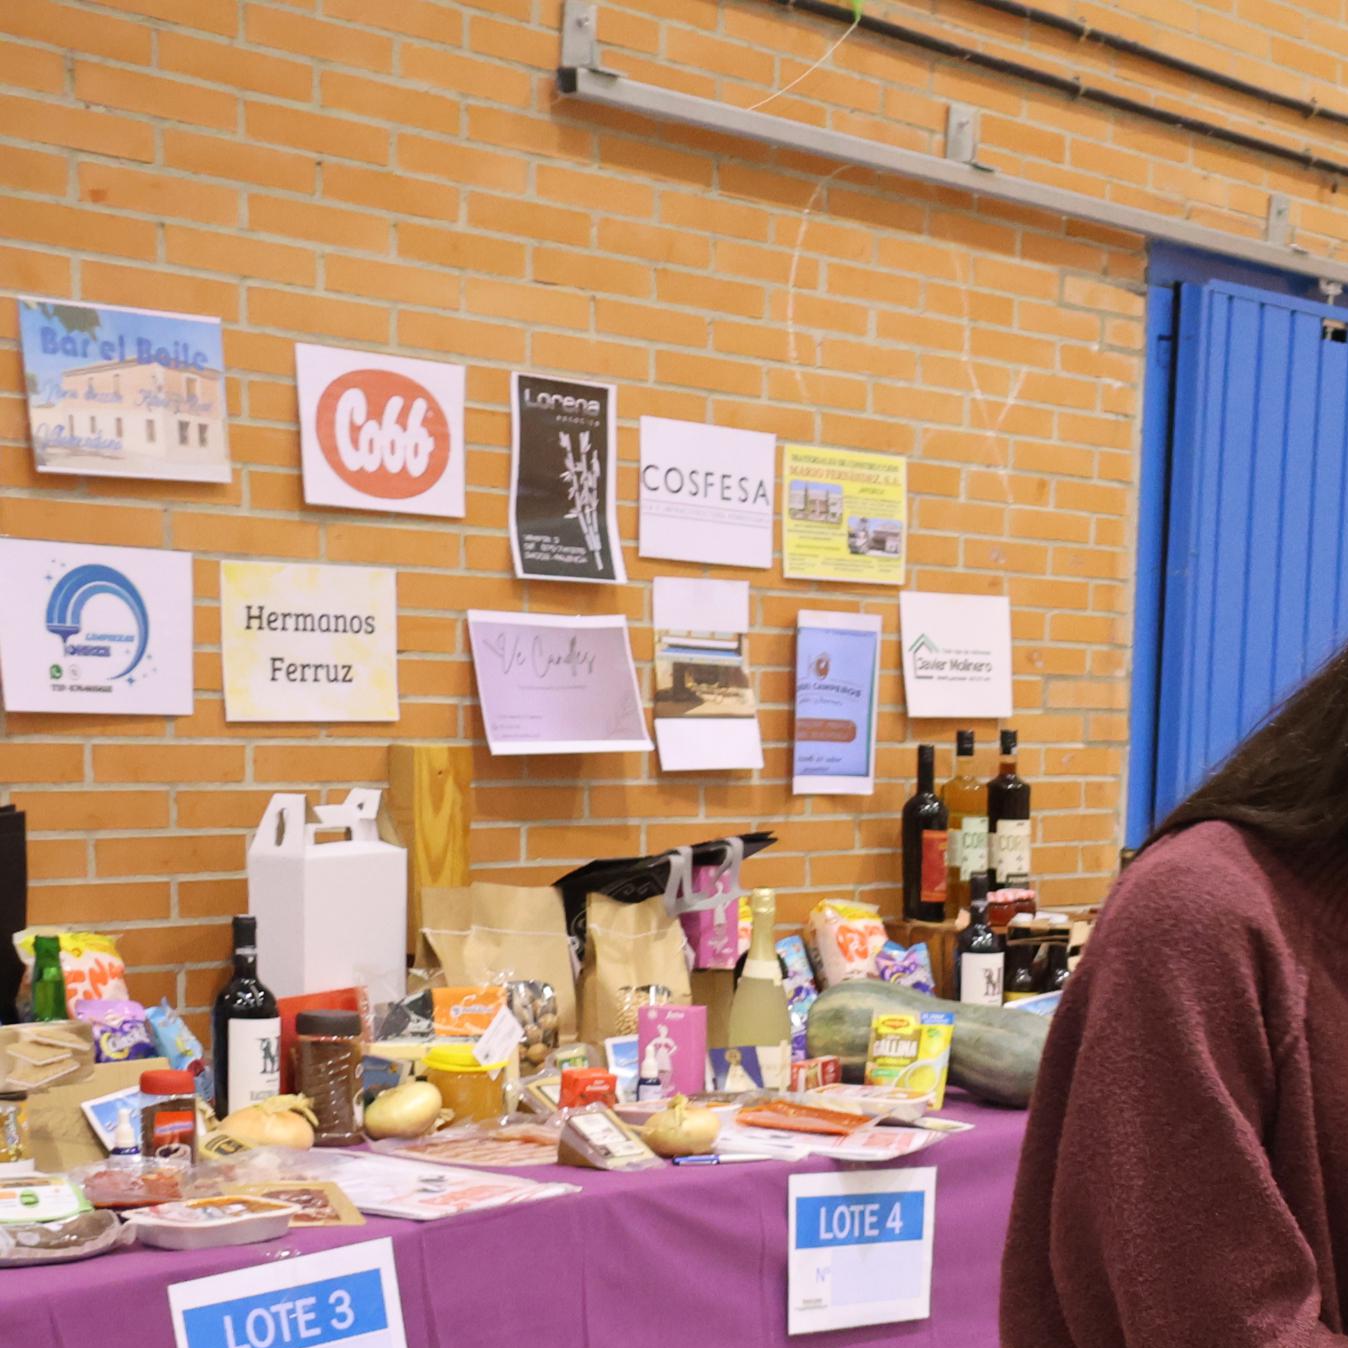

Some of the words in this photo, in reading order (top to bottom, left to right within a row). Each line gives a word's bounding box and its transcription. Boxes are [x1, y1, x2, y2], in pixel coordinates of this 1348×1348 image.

[524, 388, 600, 415] Lorena
[335, 387, 434, 478] Cobb
[642, 464, 770, 506] COSFESA
[245, 605, 376, 635] Hermanos
[270, 657, 354, 684] Ferruz
[819, 1203, 880, 1240] LOTE
[886, 1201, 903, 1234] 4
[328, 1289, 355, 1330] 3
